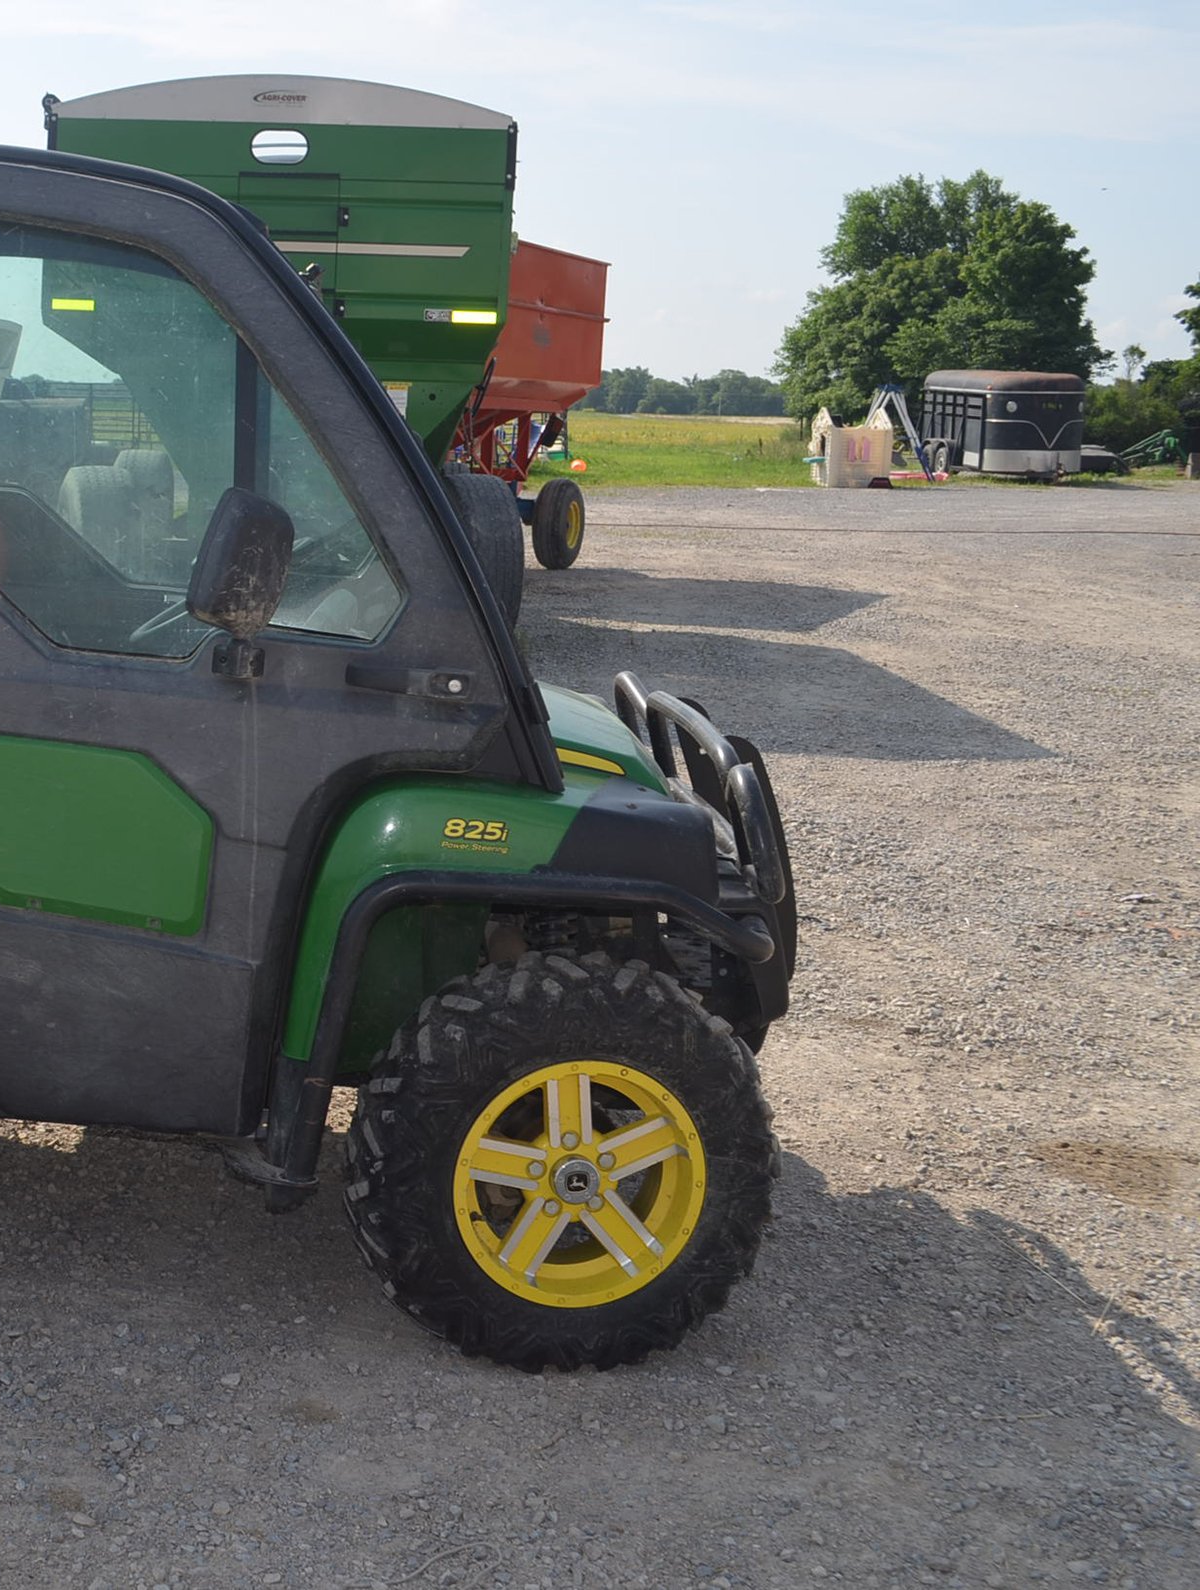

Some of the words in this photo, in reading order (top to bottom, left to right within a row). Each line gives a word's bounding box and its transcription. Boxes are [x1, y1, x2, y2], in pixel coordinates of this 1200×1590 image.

[444, 818, 508, 841] 825i
[441, 841, 469, 850] Power
[472, 843, 508, 854] Steering
